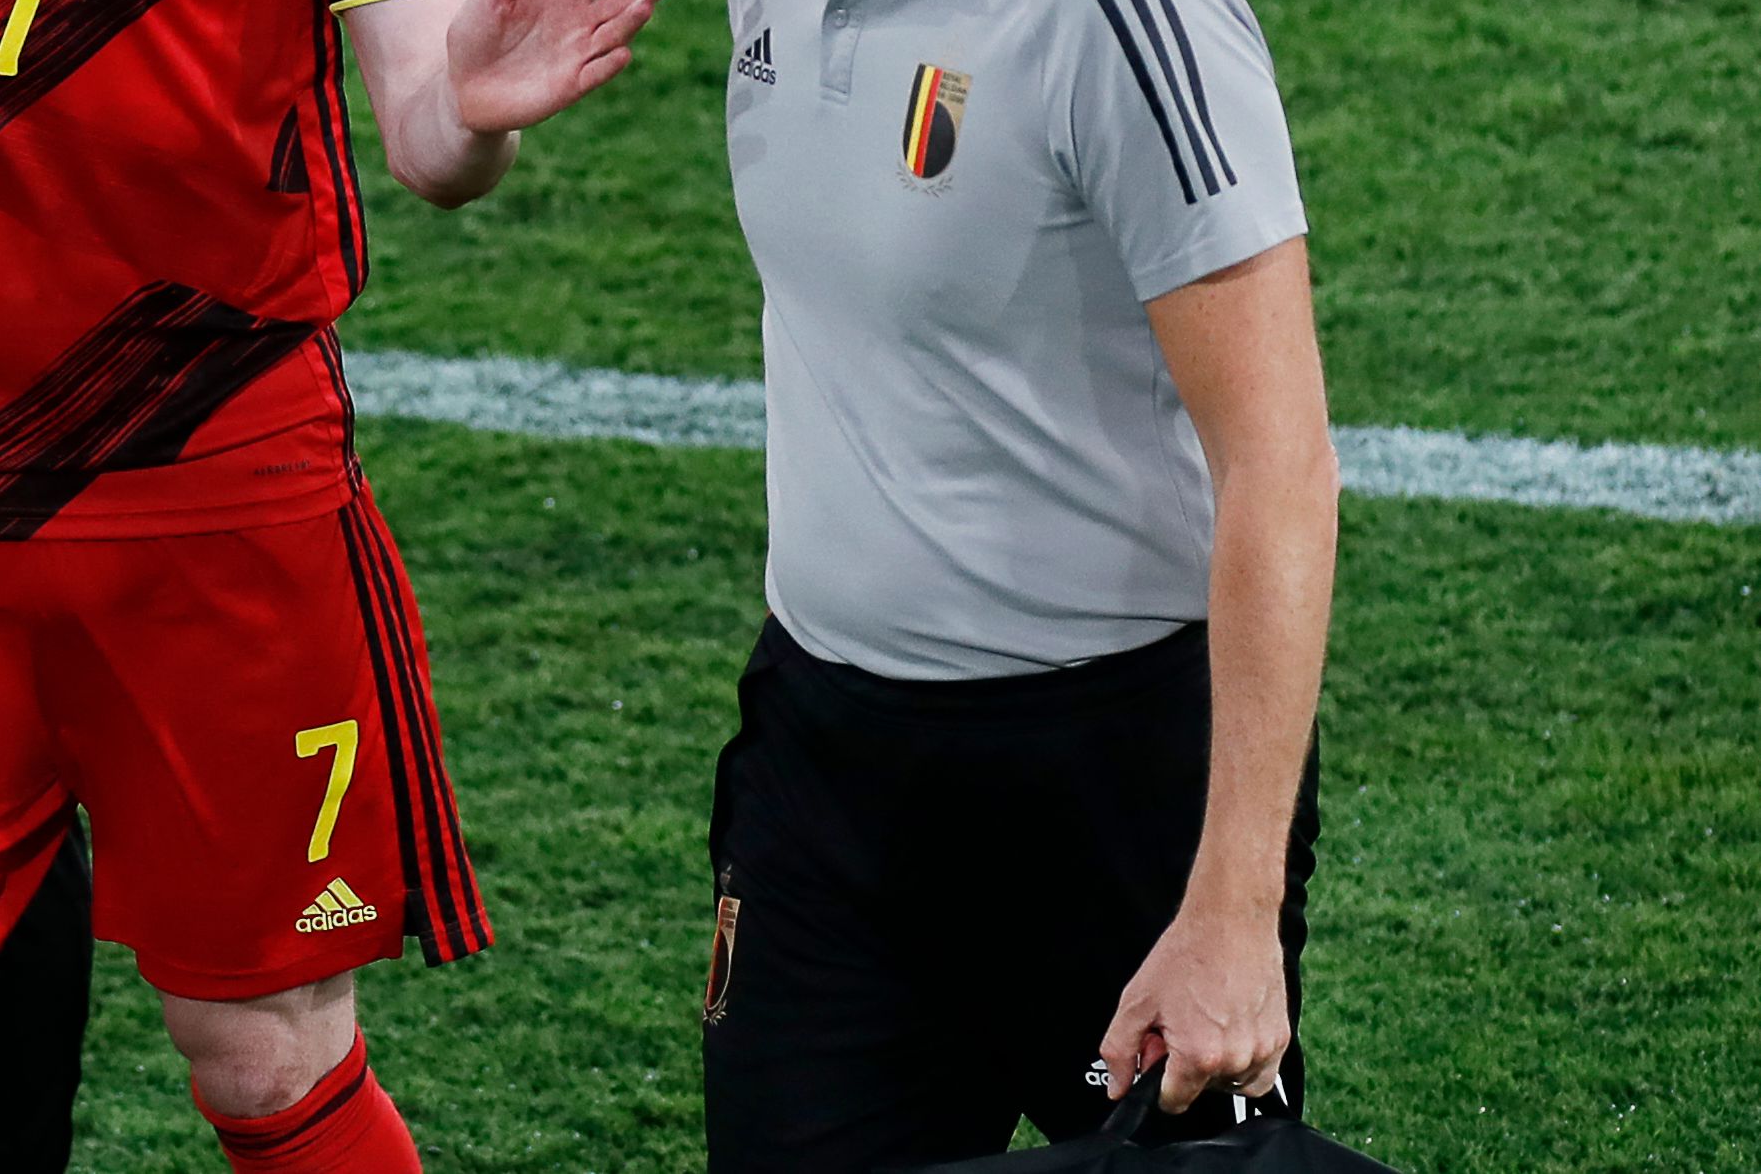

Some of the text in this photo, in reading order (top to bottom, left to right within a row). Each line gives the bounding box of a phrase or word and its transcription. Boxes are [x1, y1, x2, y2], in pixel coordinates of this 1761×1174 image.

[737, 57, 776, 85] adidas
[295, 719, 358, 863] 7
[295, 905, 378, 933] adidas
